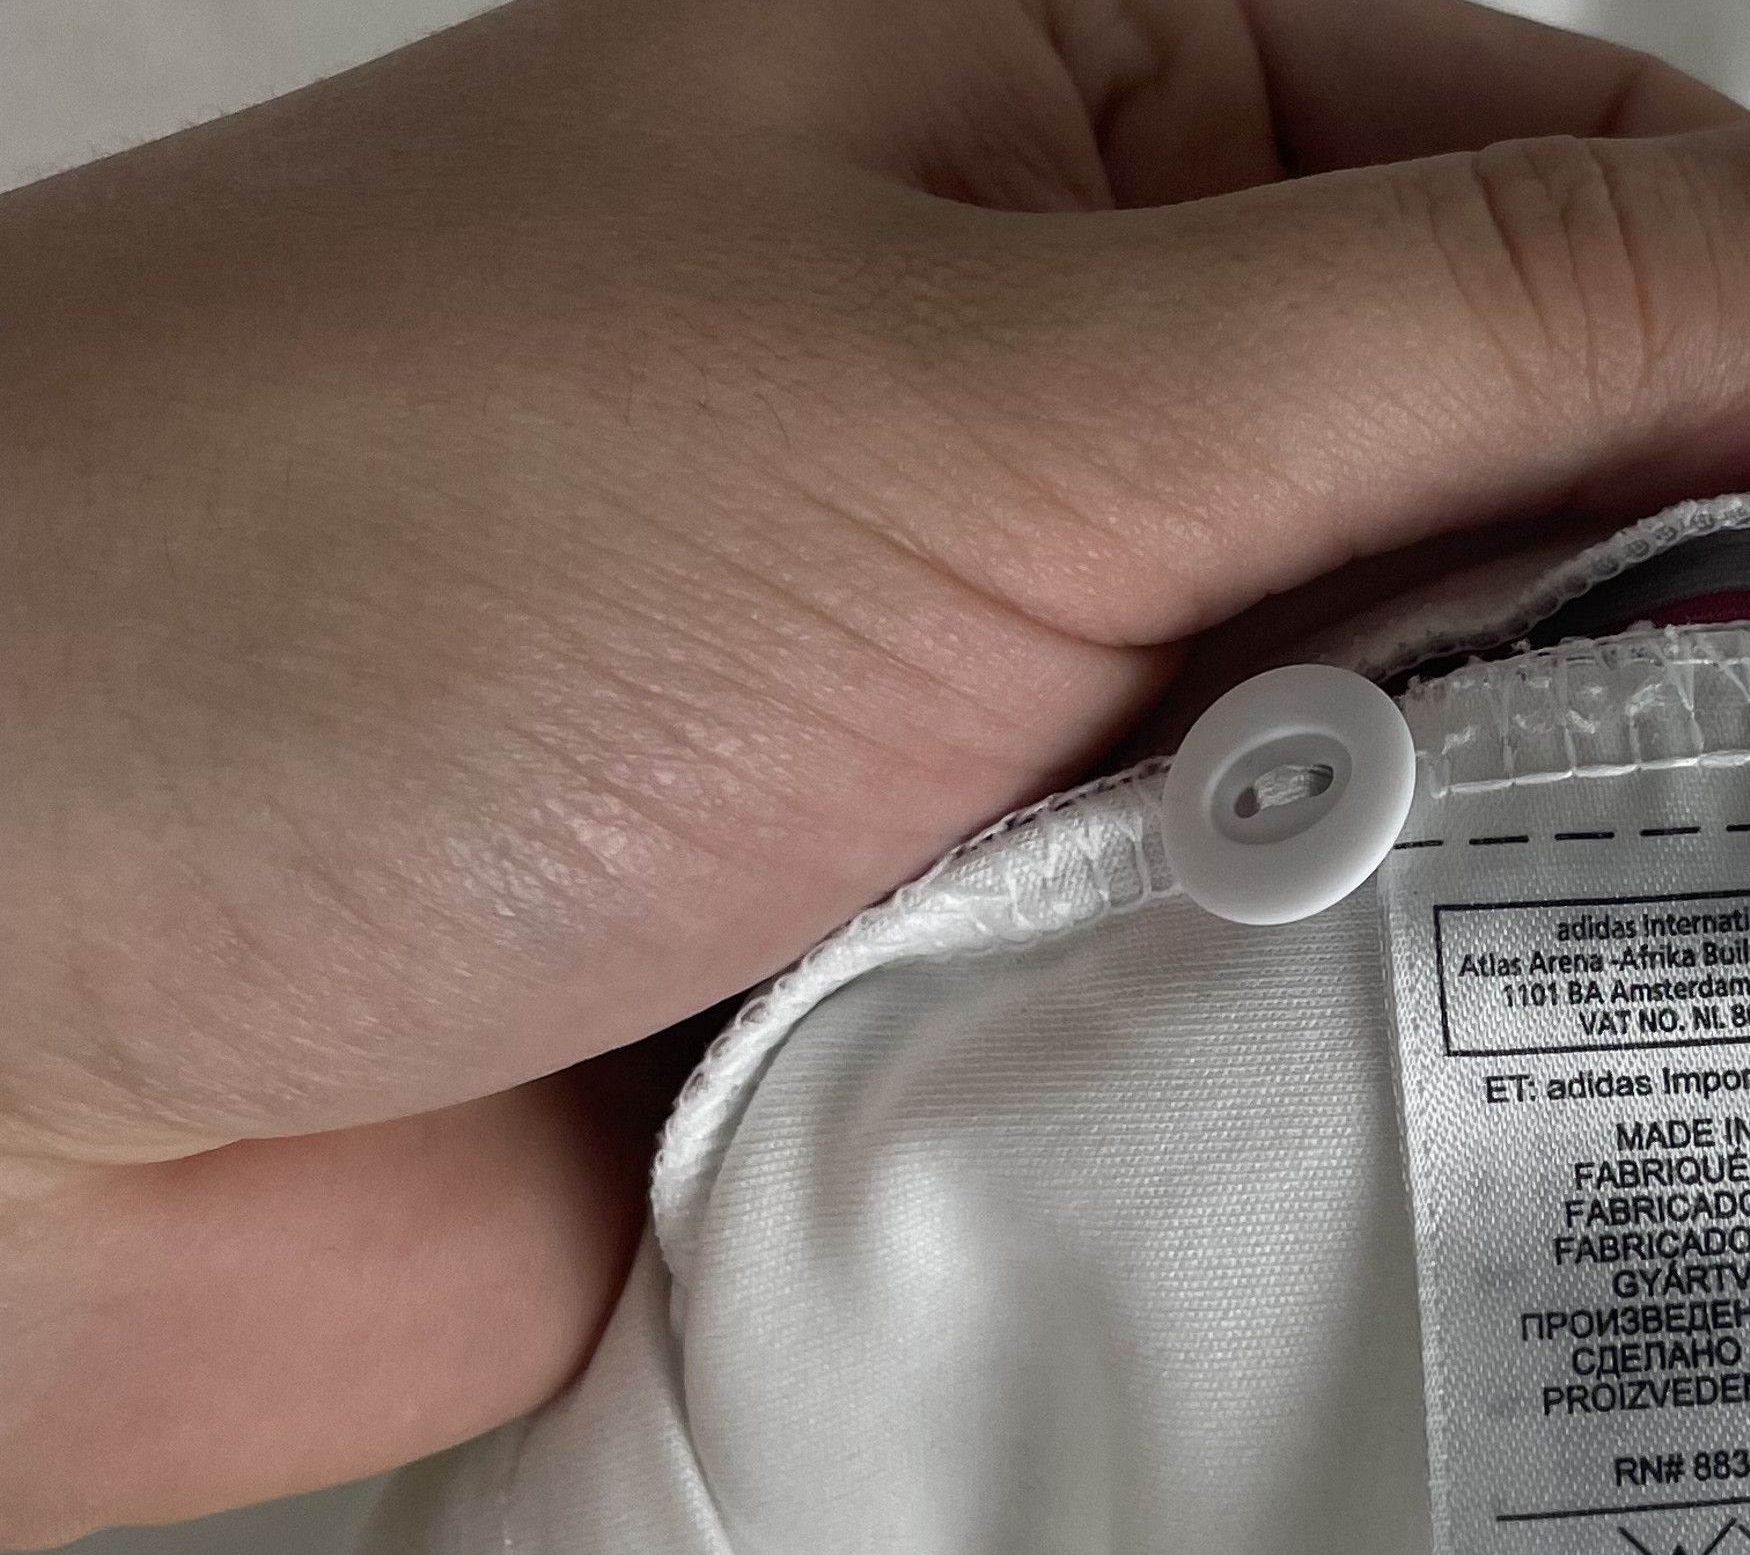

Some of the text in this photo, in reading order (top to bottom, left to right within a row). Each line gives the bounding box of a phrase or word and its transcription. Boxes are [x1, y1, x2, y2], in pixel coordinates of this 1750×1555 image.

[1558, 914, 1636, 941] adidas
[1459, 952, 1521, 976] Atlas
[1530, 951, 1603, 974] Arena
[1504, 982, 1557, 1007] 1101
[1568, 980, 1604, 1004] BA
[1610, 974, 1749, 1004] Amsterdam
[1579, 1010, 1630, 1035] VAT
[1640, 1008, 1684, 1032] NO.
[1693, 1006, 1724, 1030] NL
[1486, 1074, 1536, 1103] ET:
[1550, 1070, 1650, 1100] adidas
[1617, 1118, 1715, 1151] MADE
[1575, 1148, 1749, 1189] FABRIQUÉ
[1572, 1336, 1741, 1380] СДЕЛАНО
[1614, 1452, 1684, 1486] RN#
